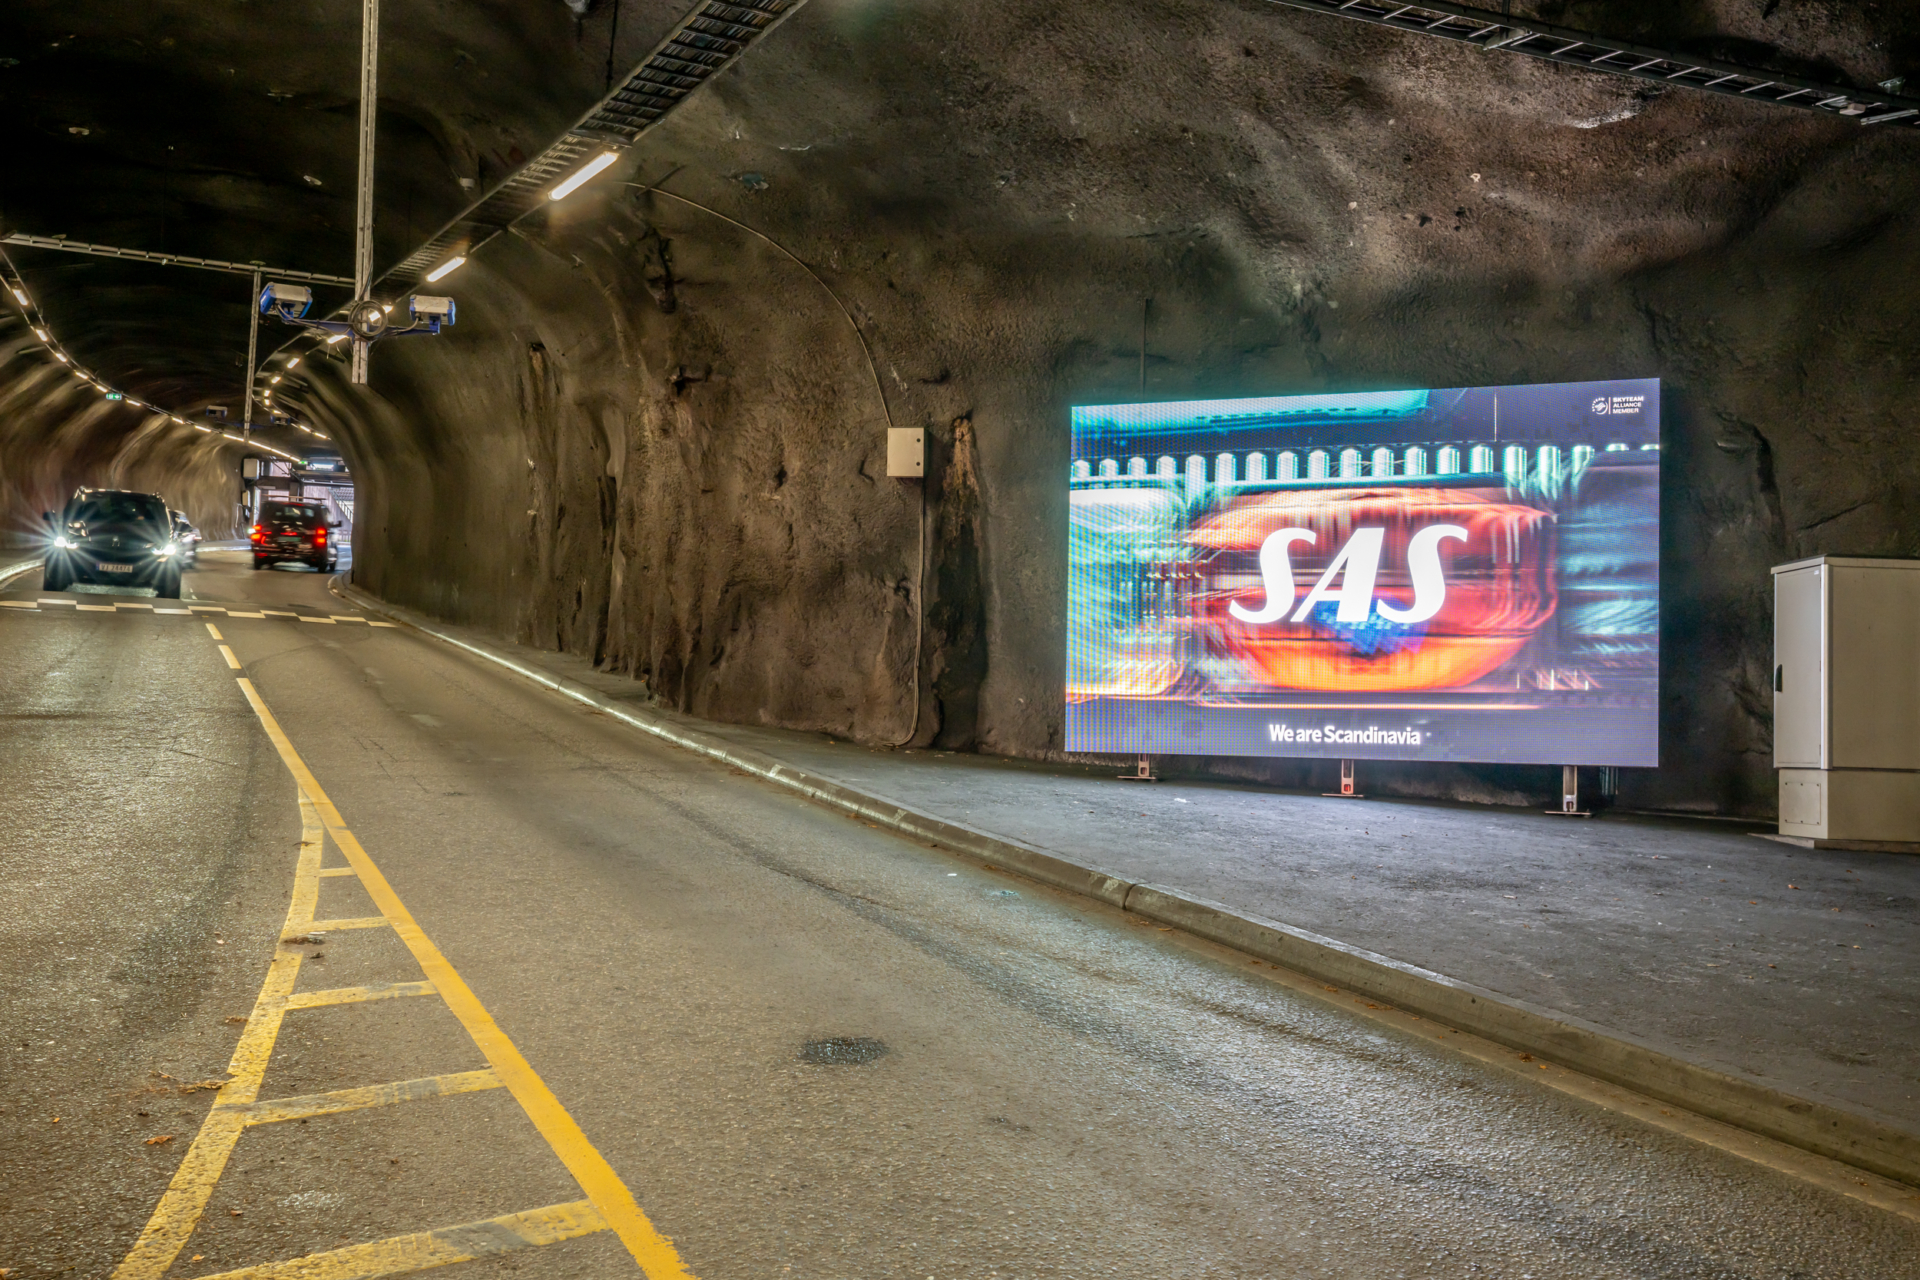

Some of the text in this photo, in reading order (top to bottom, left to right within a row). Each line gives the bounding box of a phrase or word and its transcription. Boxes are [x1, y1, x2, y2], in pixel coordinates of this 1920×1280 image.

[1229, 524, 1468, 623] SAS
[1269, 724, 1421, 745] We are Scandinavia
